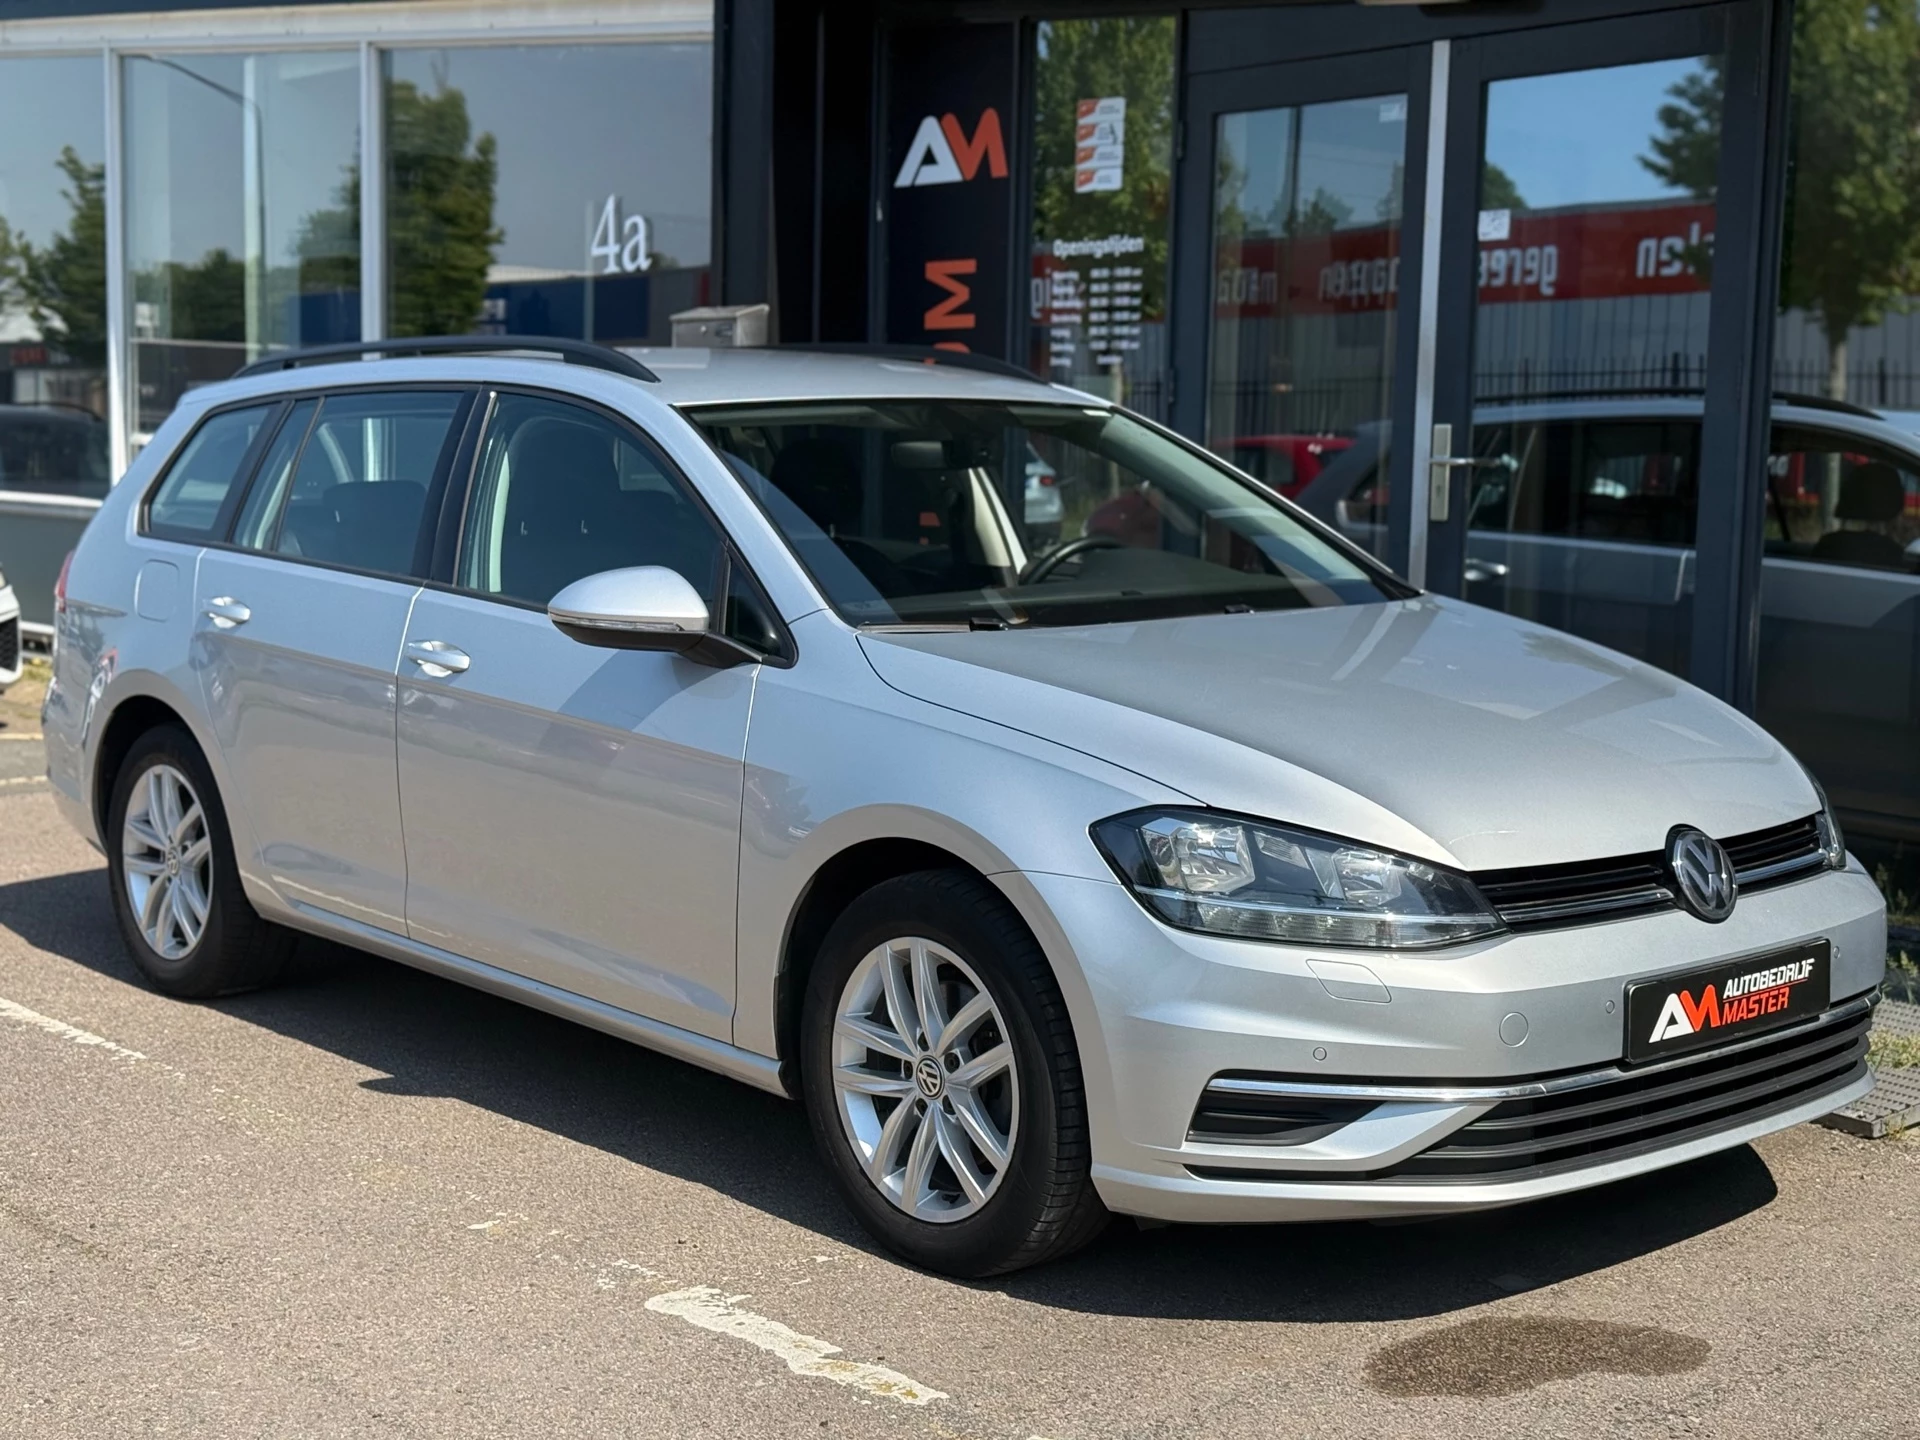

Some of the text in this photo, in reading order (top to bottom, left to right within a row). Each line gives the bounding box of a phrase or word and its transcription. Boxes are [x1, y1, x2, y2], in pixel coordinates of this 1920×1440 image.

[894, 107, 1008, 188] AM
[590, 193, 652, 274] 4a
[1052, 234, 1145, 259] Openingstijden
[1722, 958, 1815, 999] AUTOBEDRIJF
[1648, 984, 1721, 1044] AM
[1722, 986, 1790, 1026] MASTER
